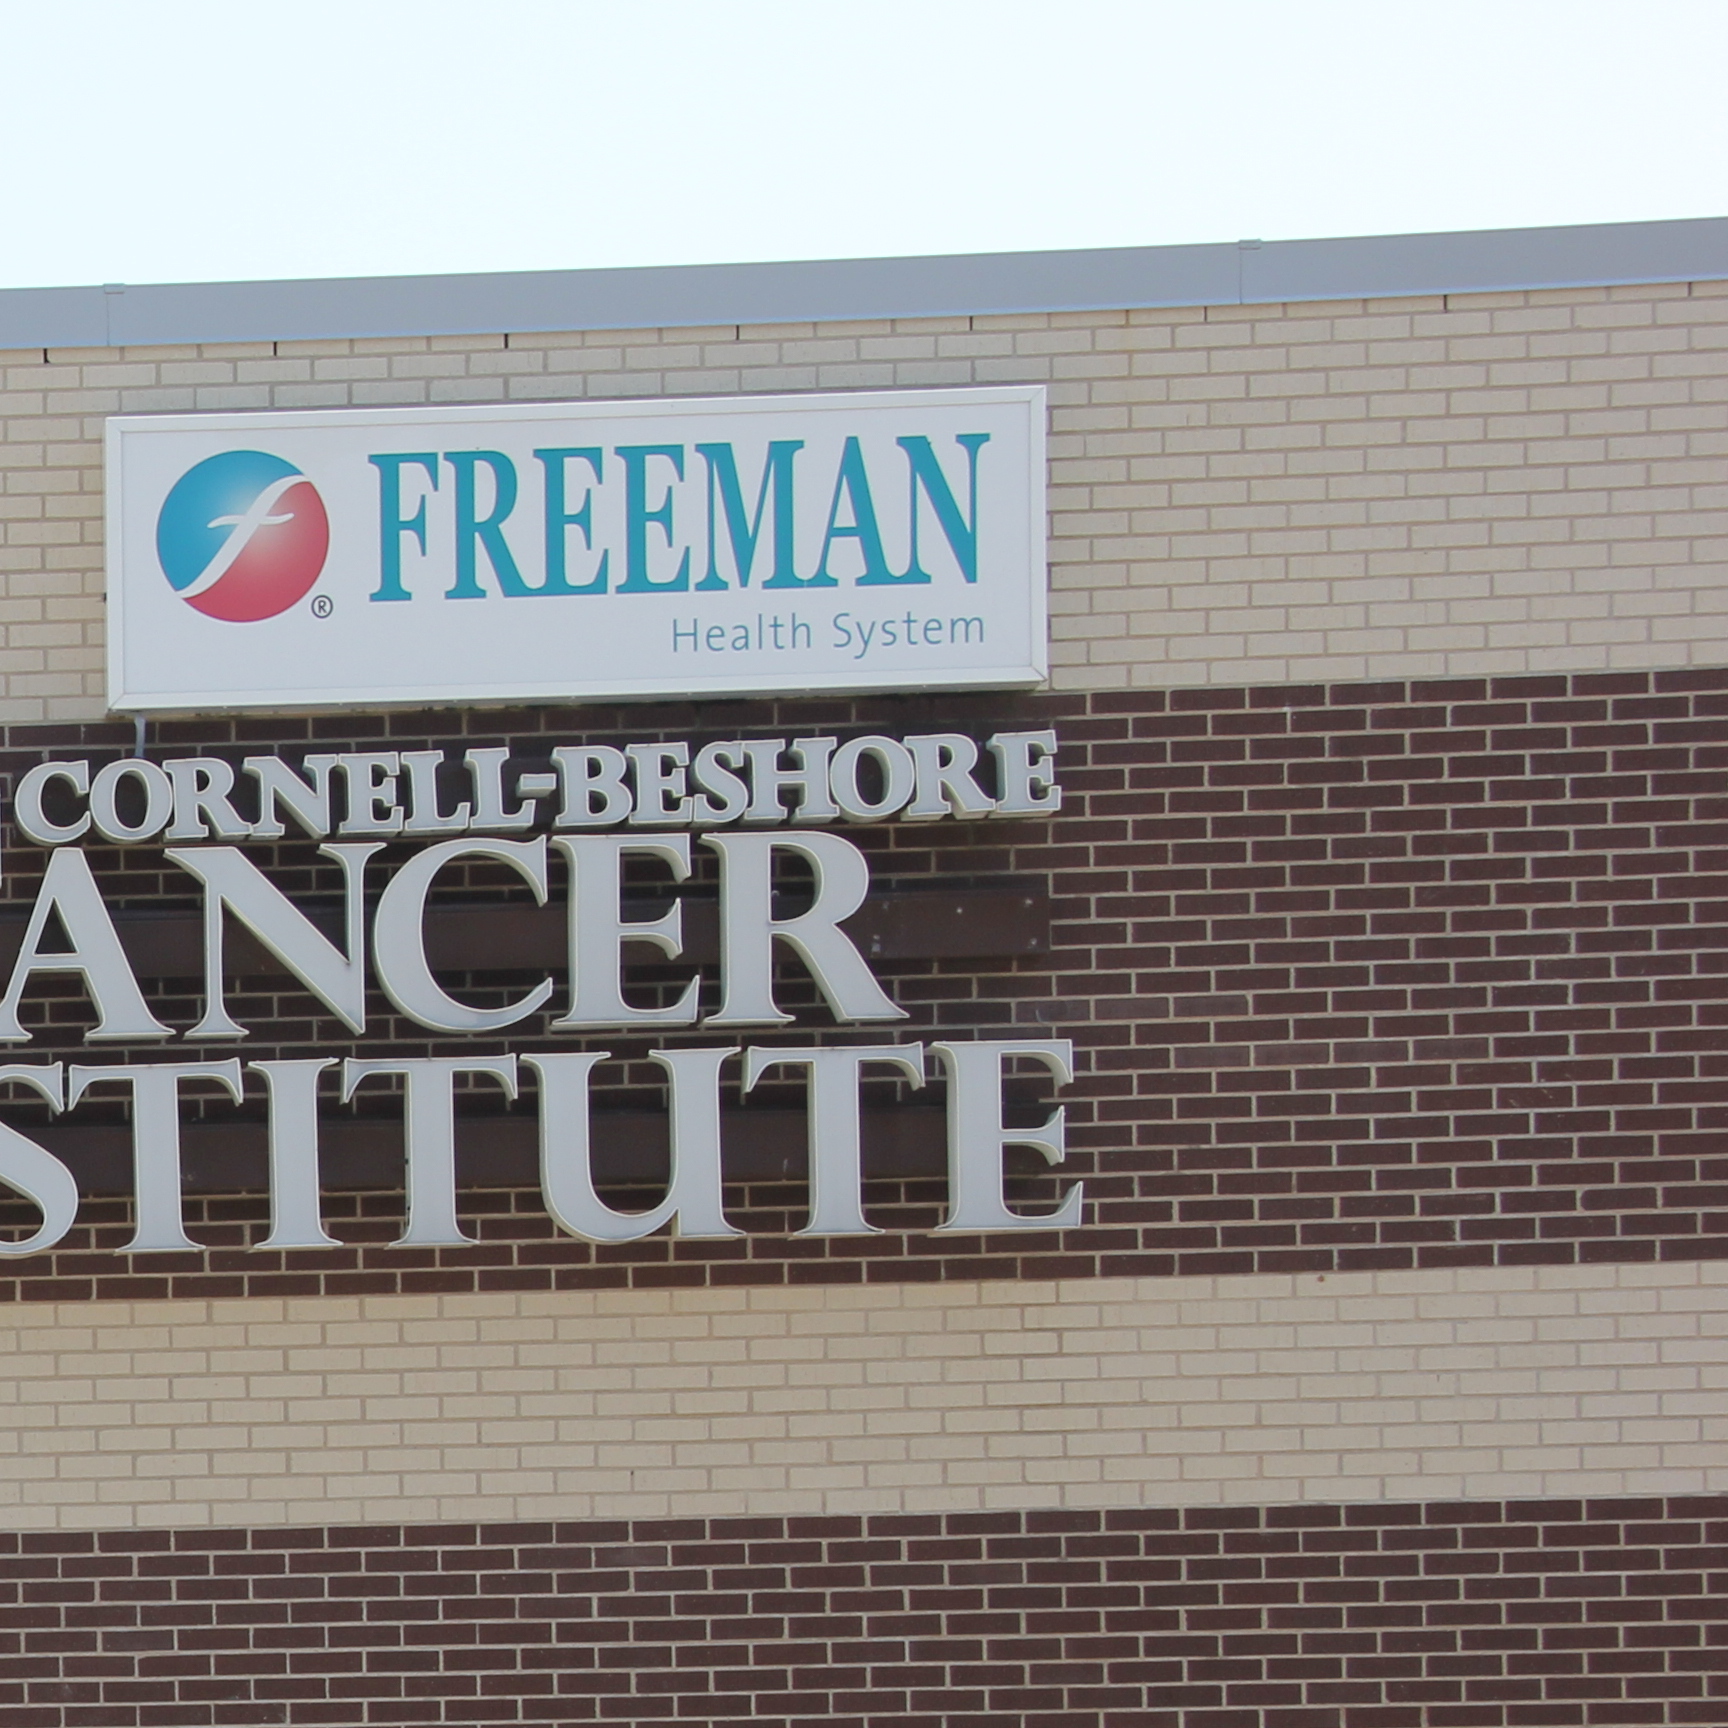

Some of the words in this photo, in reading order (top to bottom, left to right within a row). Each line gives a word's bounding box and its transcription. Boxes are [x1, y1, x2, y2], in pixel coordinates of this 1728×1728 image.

[368, 432, 992, 602] FREEMAN
[672, 611, 813, 656] Health
[832, 607, 986, 662] System
[12, 728, 1064, 846] CORNELL-BESHORE
